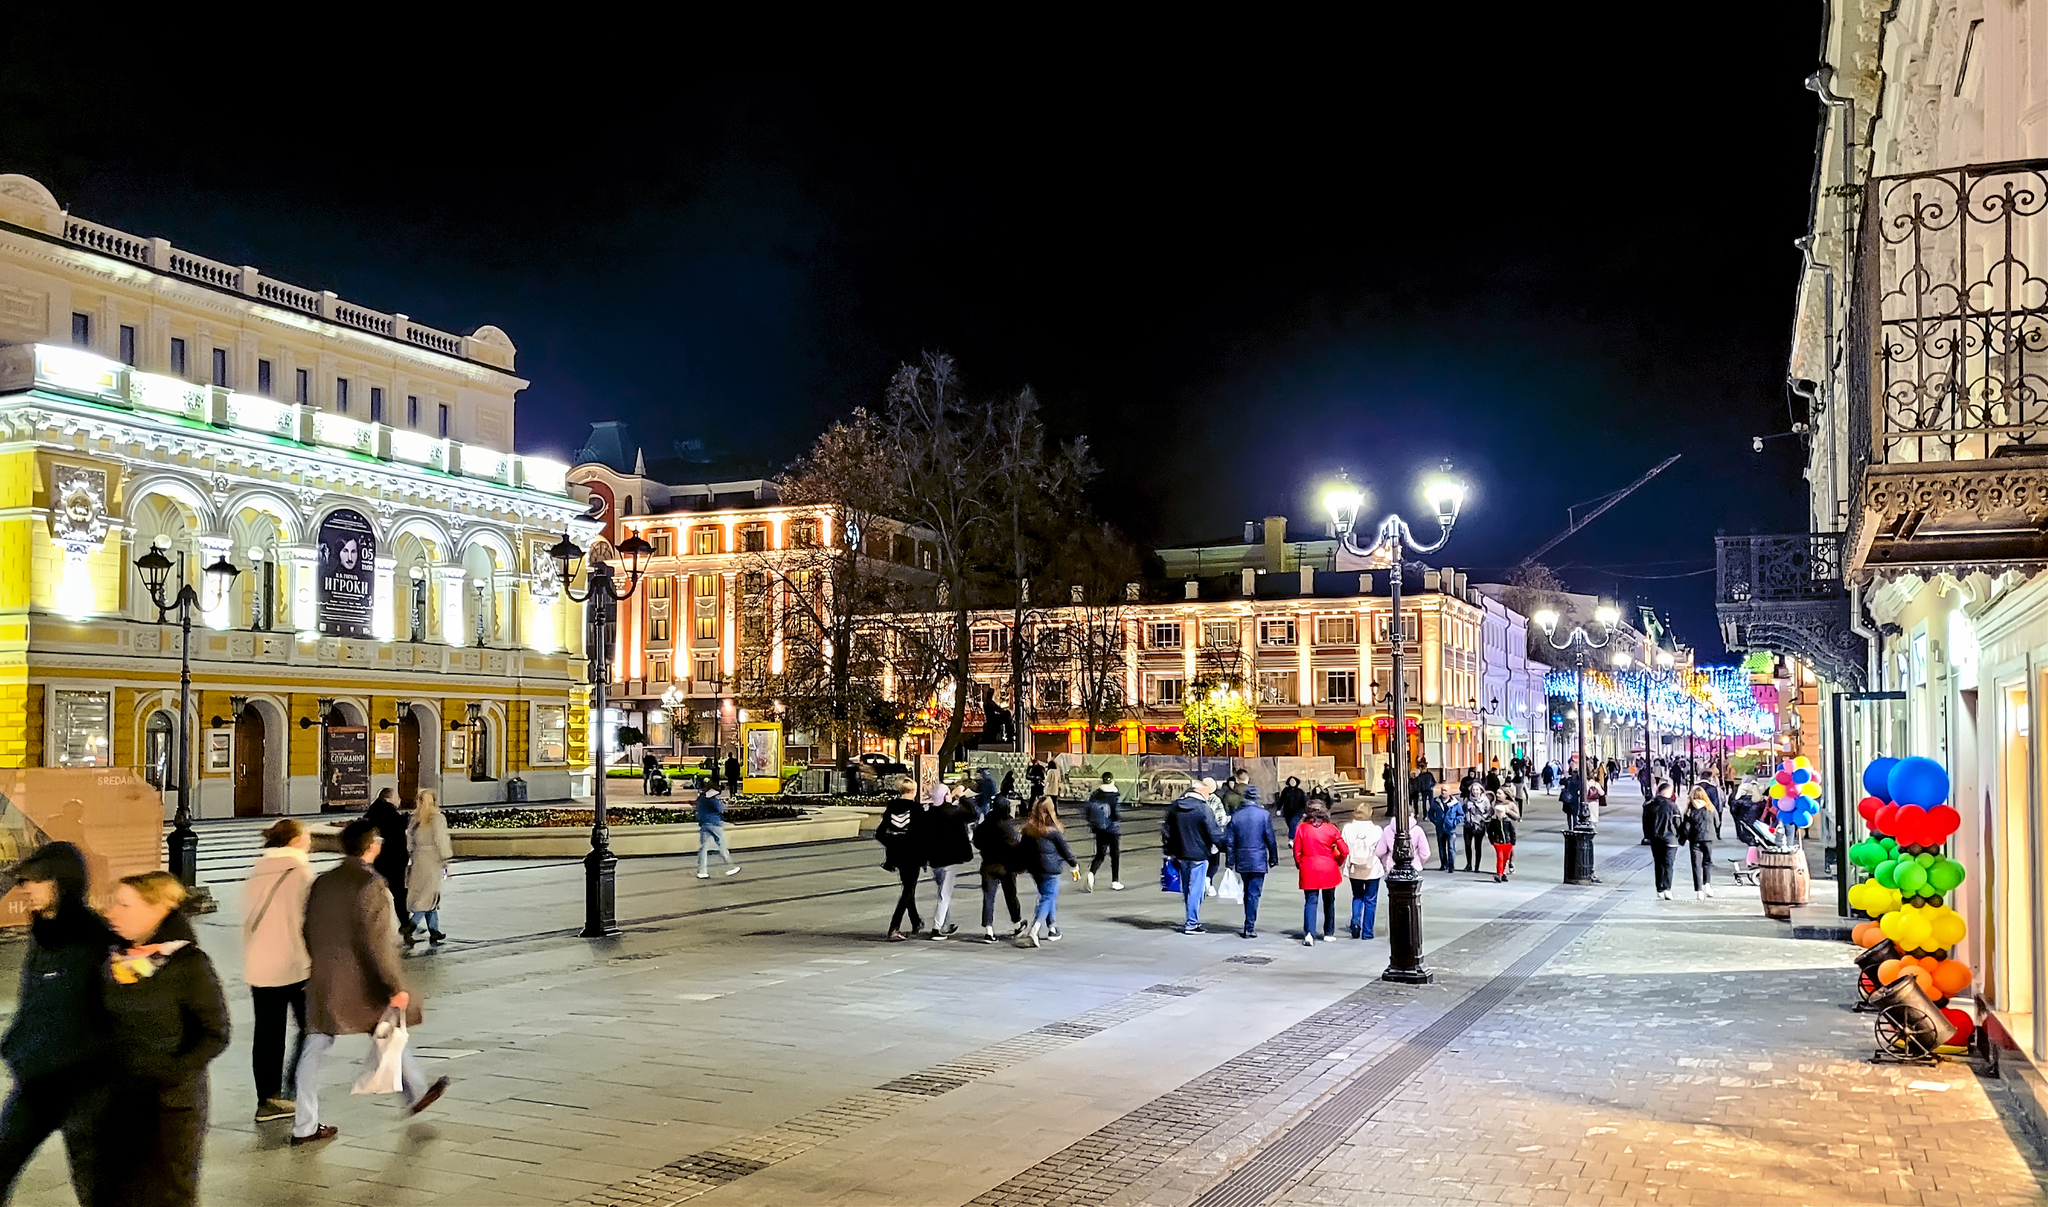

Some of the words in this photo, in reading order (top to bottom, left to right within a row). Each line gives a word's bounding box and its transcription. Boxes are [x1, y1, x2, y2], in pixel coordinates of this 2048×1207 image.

[361, 548, 373, 560] 05
[325, 577, 368, 594] ИГРОКИ
[331, 755, 365, 763] СЛУЖАНКИ
